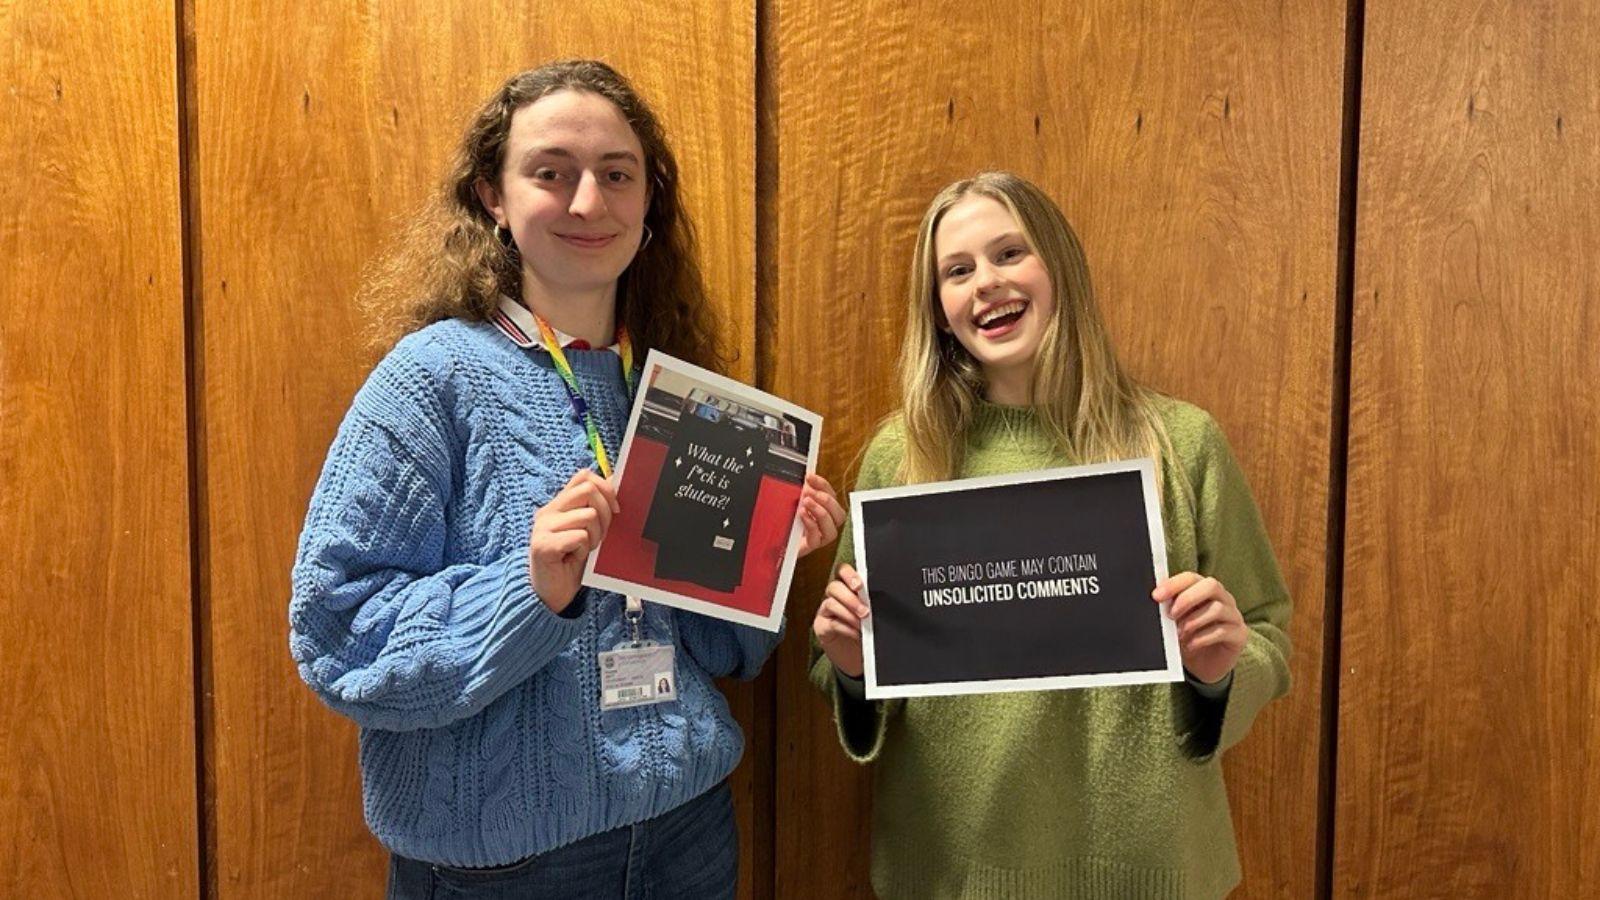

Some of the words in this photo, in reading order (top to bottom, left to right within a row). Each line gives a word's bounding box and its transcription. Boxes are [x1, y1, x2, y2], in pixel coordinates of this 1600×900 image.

[688, 443, 722, 466] What
[722, 457, 744, 474] the
[674, 484, 731, 510] gluten?!
[718, 475, 731, 490] is
[922, 566, 946, 584] THIS
[949, 563, 983, 583] BINGO
[986, 560, 1018, 580] GAME
[1021, 557, 1045, 577] MAY
[1048, 553, 1098, 575] CONTAIN
[923, 583, 1014, 608] UNSOLICITED
[1017, 576, 1100, 600] COMMENTS
